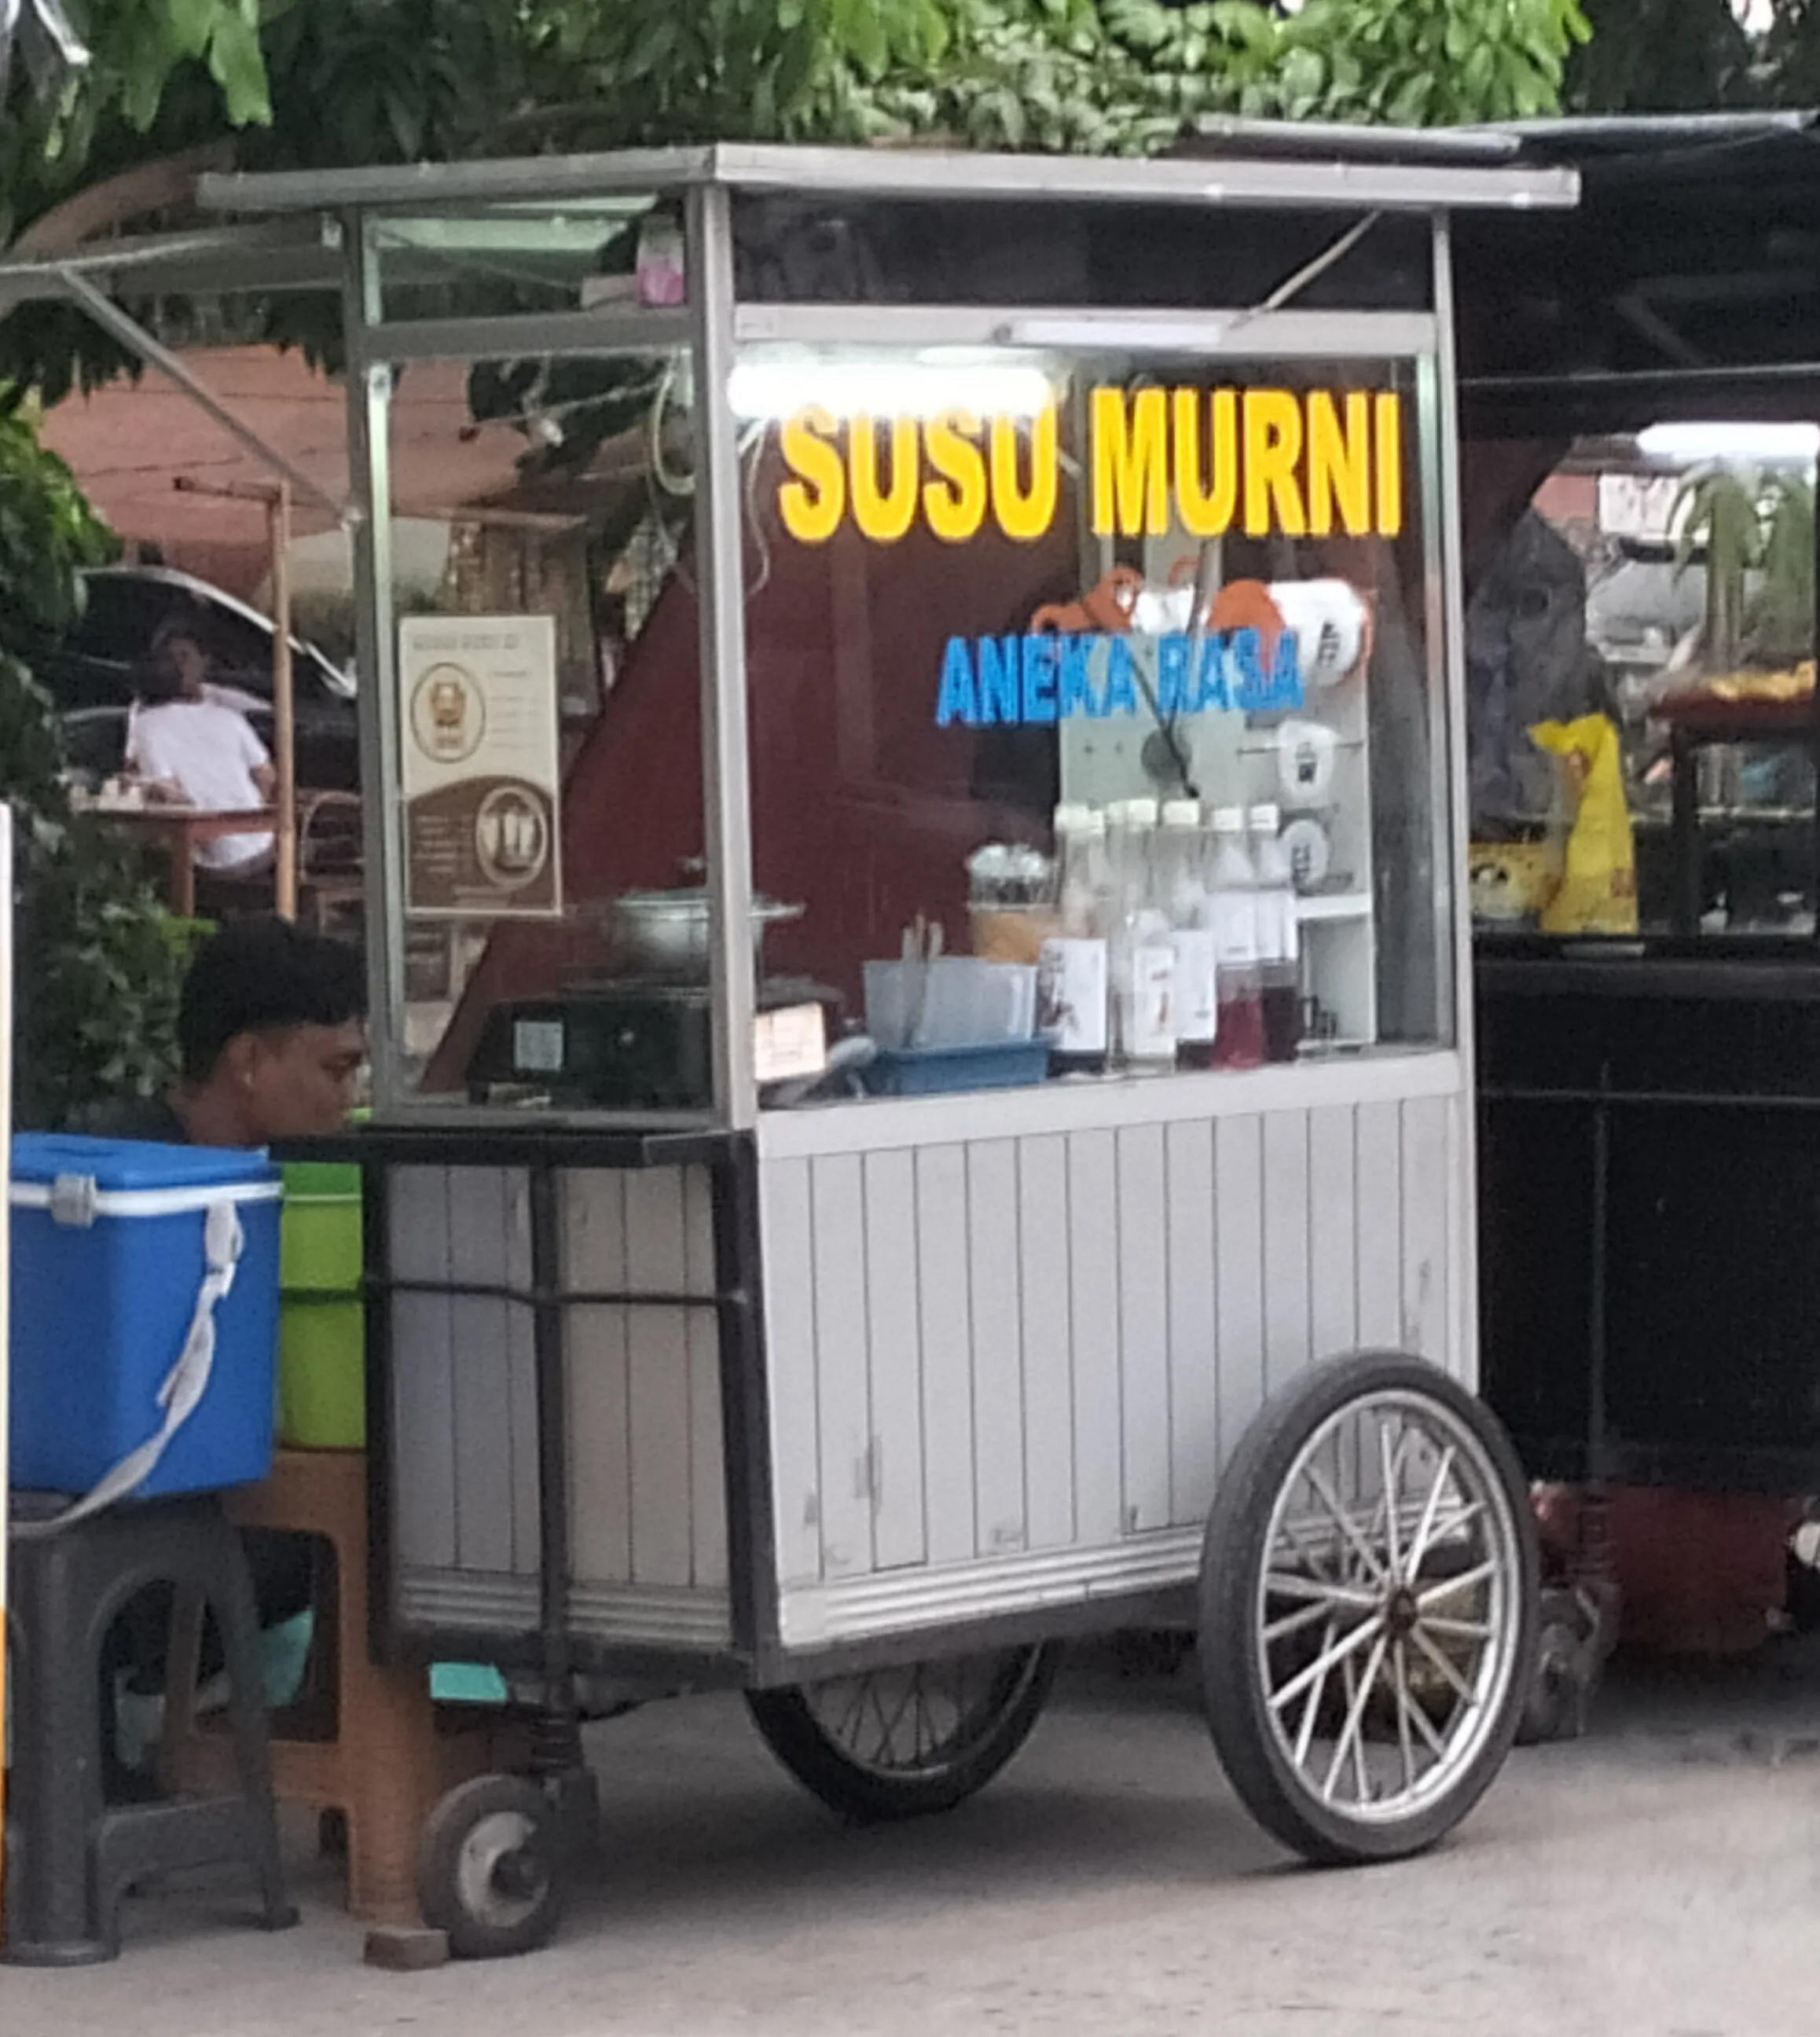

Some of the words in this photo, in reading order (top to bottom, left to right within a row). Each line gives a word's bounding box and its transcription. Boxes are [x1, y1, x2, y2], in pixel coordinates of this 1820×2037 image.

[778, 395, 1058, 541] SUSU
[1092, 386, 1402, 538] MURNI
[936, 632, 1137, 729] ANEKA
[1157, 627, 1304, 715] RASA
